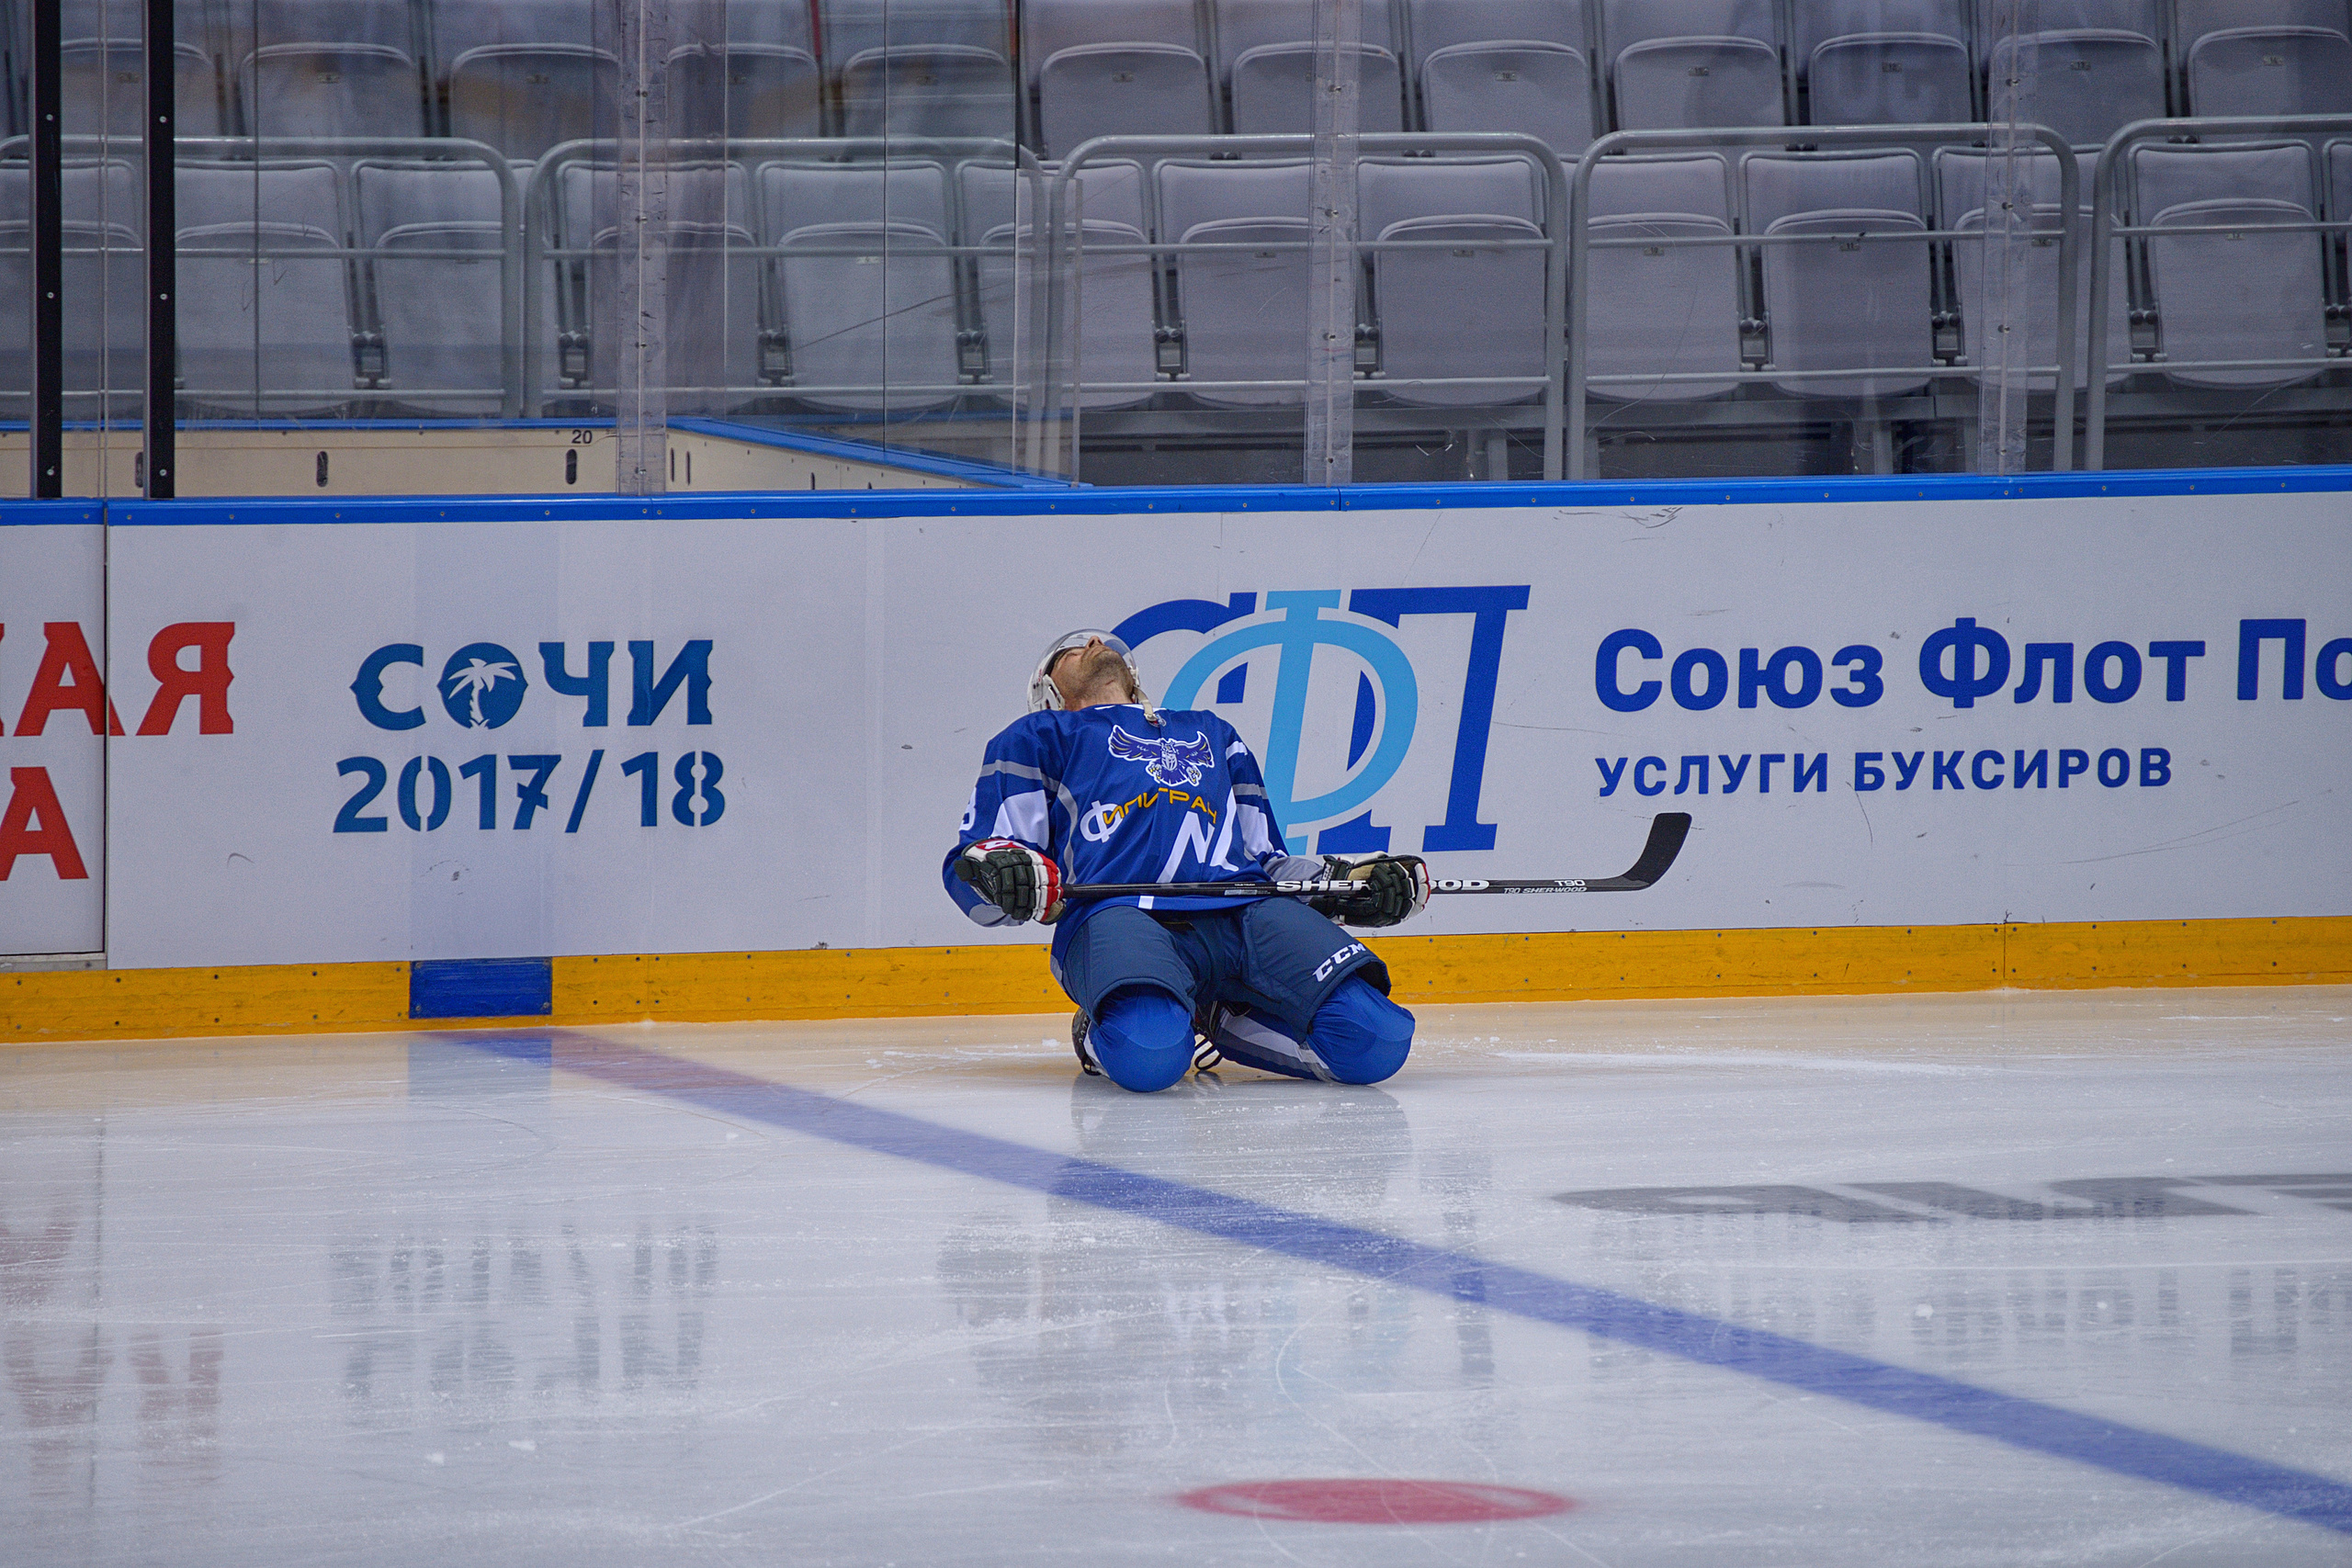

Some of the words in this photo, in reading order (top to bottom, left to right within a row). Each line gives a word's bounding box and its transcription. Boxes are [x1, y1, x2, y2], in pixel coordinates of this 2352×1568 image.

[571, 429, 593, 445] 20
[0, 622, 235, 737] АЯ
[350, 640, 714, 732] СОЧИ
[1595, 628, 1884, 713] Союз
[1918, 617, 2206, 709] Флот
[2237, 618, 2352, 701] По
[334, 750, 726, 835] 2017/18
[1595, 752, 1828, 797] УСЛУГИ
[1854, 748, 2172, 792] БУКСИРОВ
[1522, 886, 1588, 895] SHER-WOOD
[1312, 942, 1366, 983] CCM
